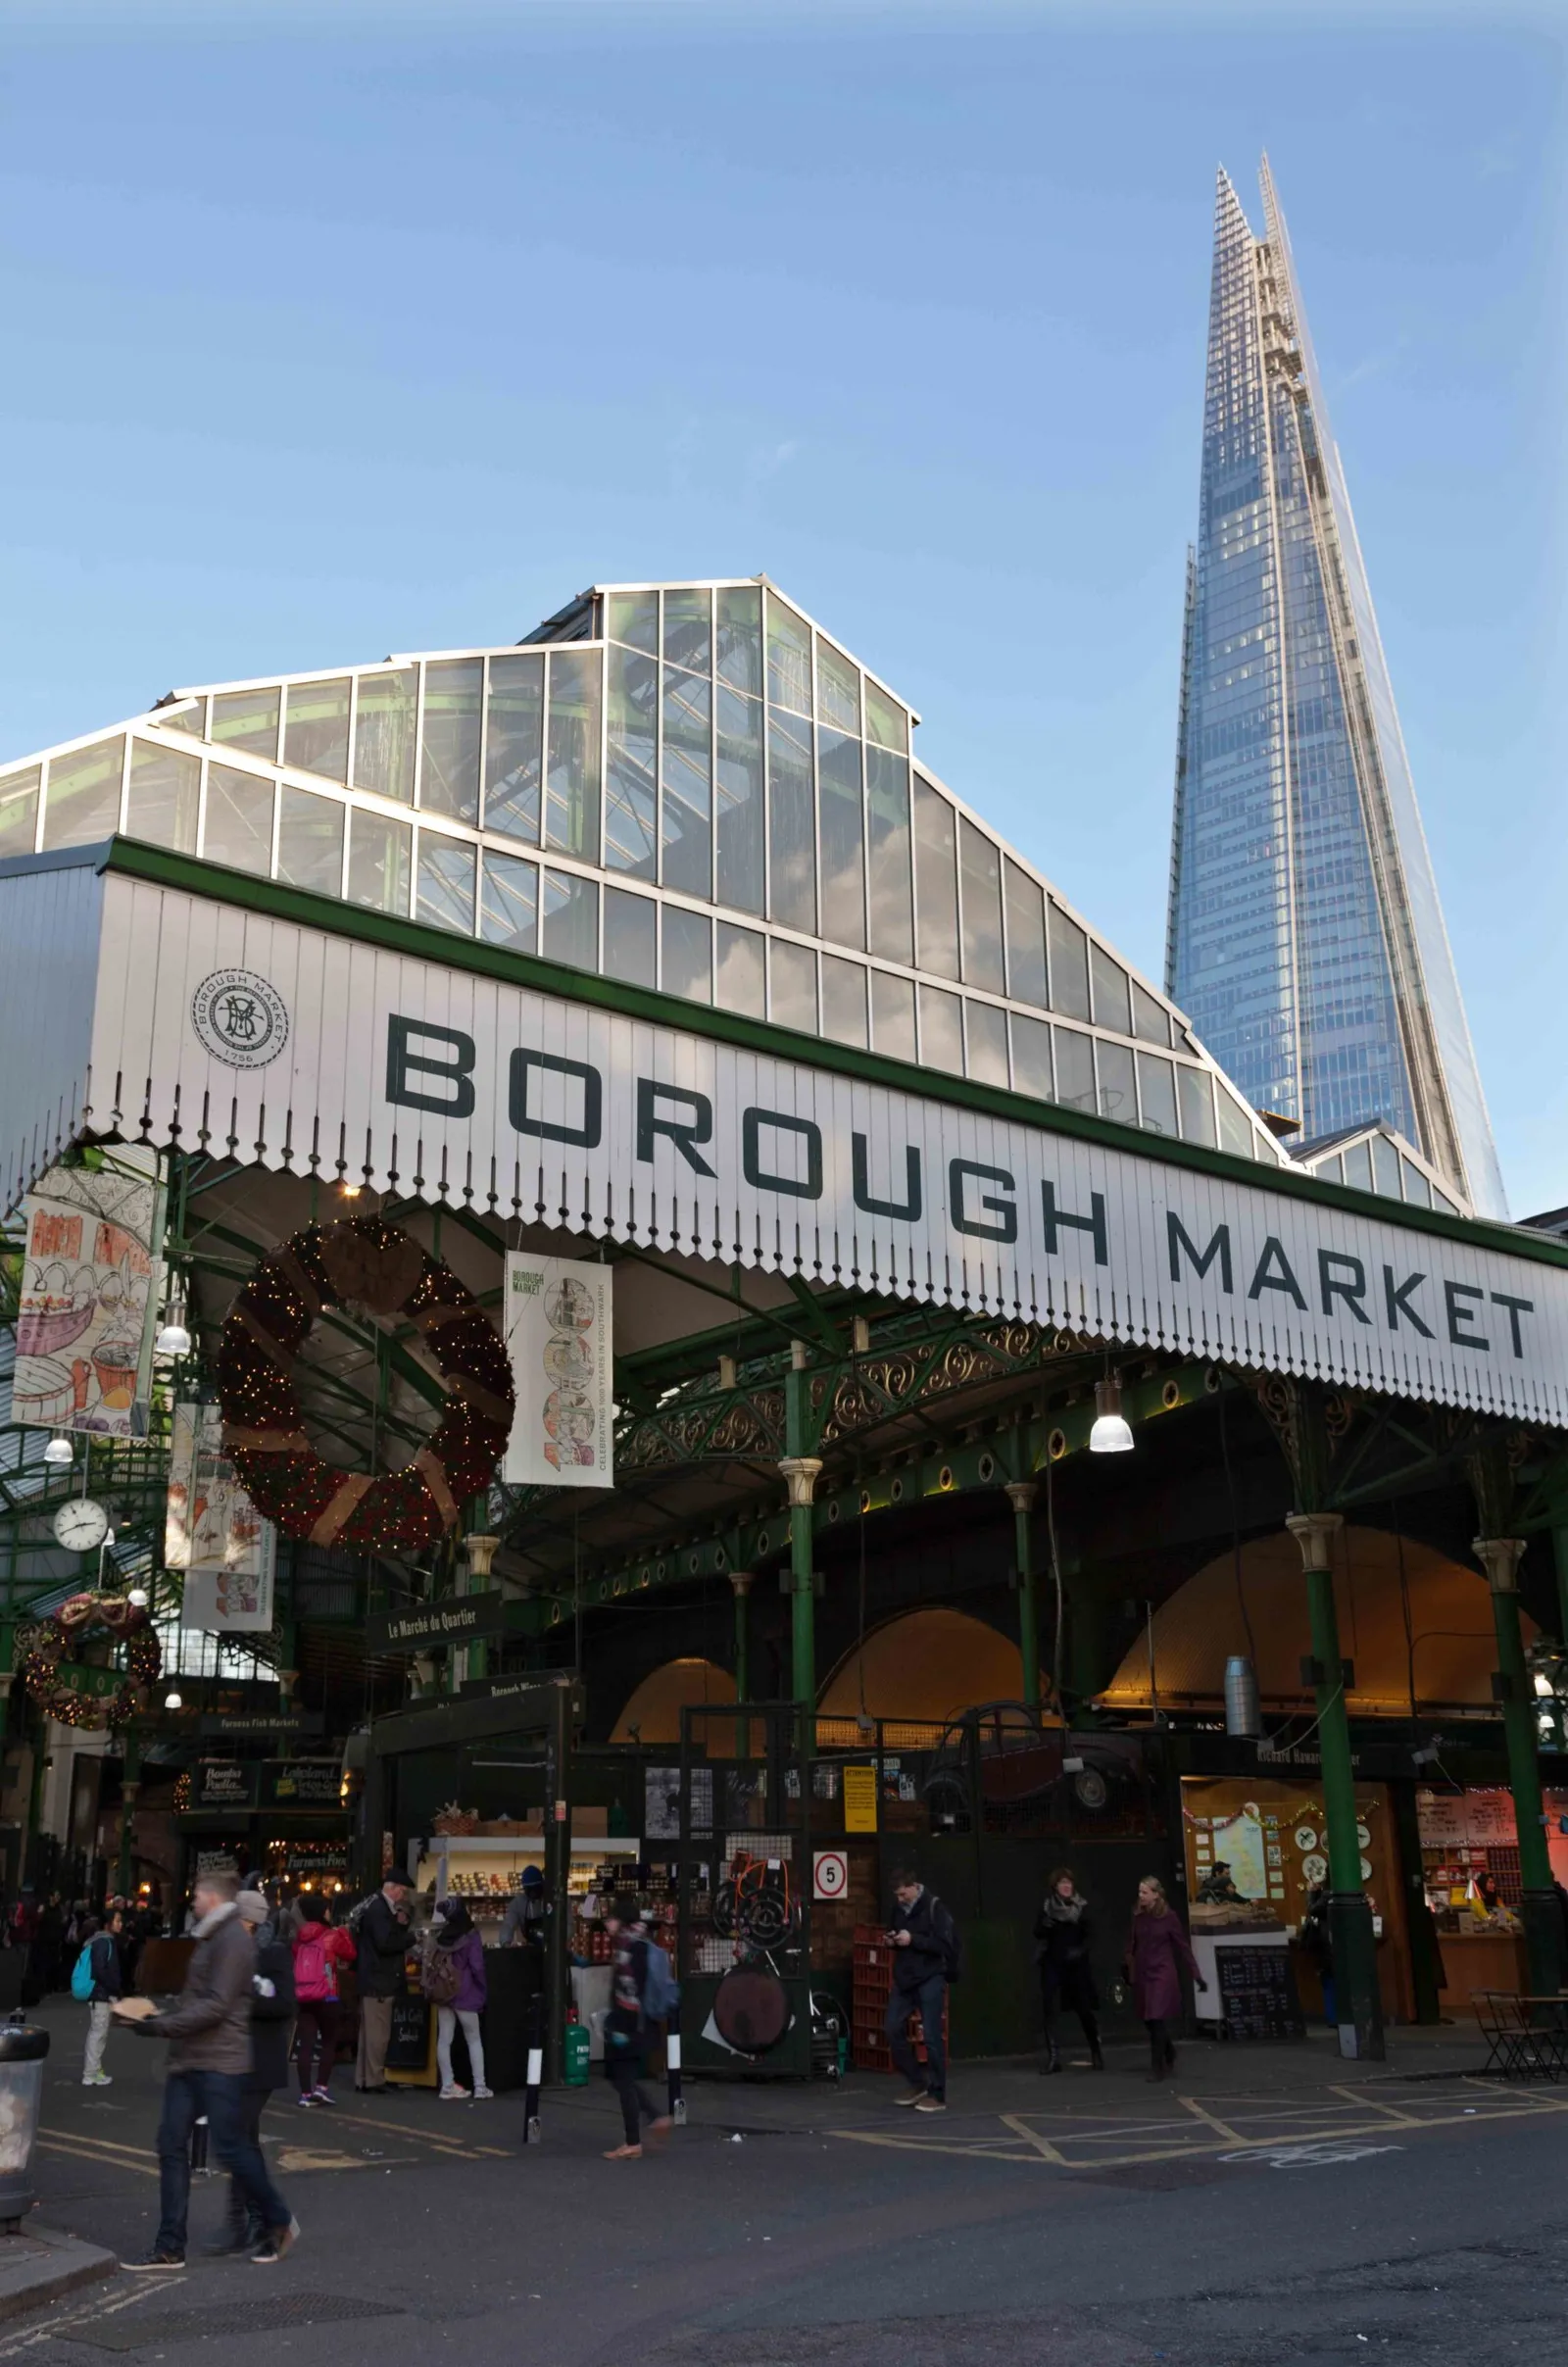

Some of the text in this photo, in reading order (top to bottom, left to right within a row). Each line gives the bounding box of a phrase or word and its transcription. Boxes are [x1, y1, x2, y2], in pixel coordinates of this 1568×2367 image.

[198, 974, 247, 1024] BOROUGH
[254, 982, 283, 1042] MARKET
[224, 1050, 253, 1062] 1756
[385, 1012, 1535, 1359] BOROUGH MARKET
[512, 1269, 545, 1286] BOROUGH
[512, 1282, 541, 1296] MARKET
[598, 1346, 605, 1355] IN
[387, 1607, 477, 1639] Le Marché du Quartier
[252, 1717, 268, 1728] Fish
[269, 1717, 300, 1728] Markets
[1293, 1747, 1322, 1764] Hawar
[826, 1866, 836, 1883] 5
